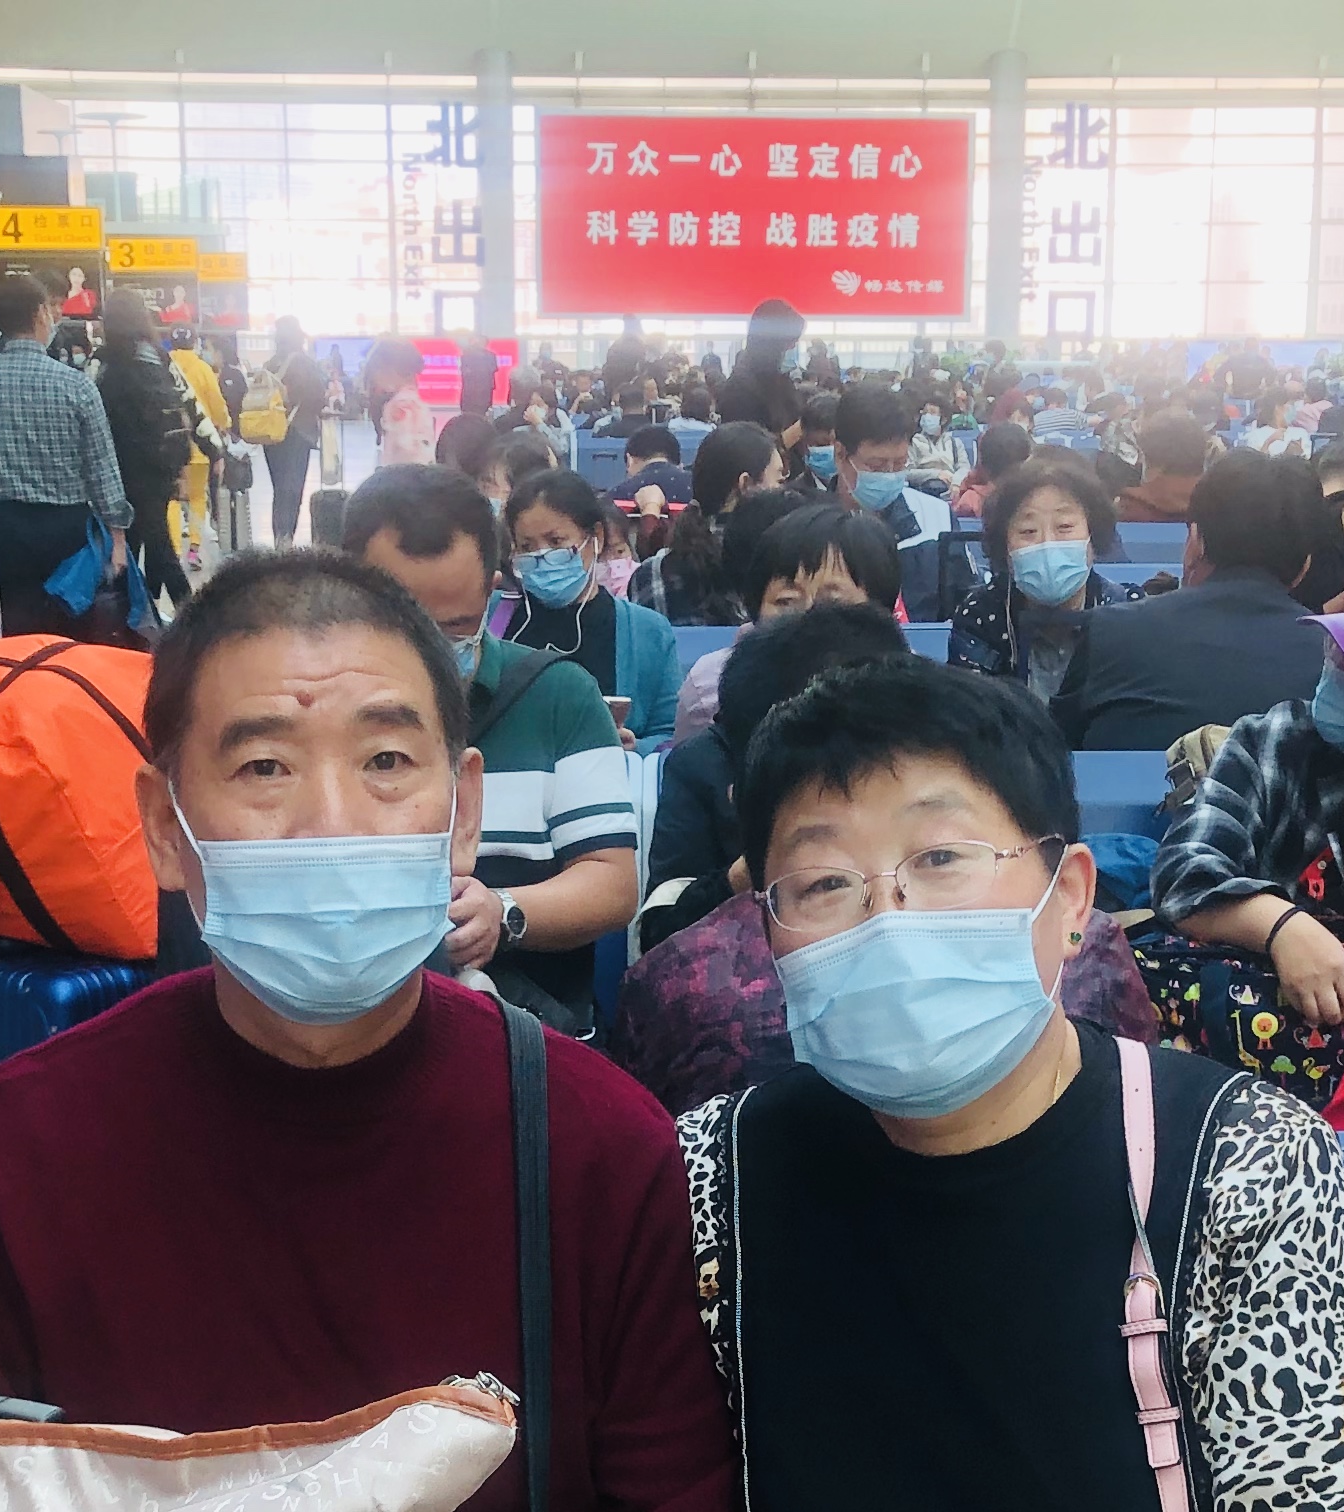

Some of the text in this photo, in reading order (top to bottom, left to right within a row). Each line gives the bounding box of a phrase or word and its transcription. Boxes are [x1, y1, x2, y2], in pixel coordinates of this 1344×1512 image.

[586, 141, 923, 179] 万众一心 坚定信心
[2, 212, 23, 243] 4
[426, 101, 485, 337] 北出口
[586, 210, 921, 248] 科学防控 战胜疫情
[1047, 102, 1108, 340] 北出口
[118, 242, 135, 268] 3
